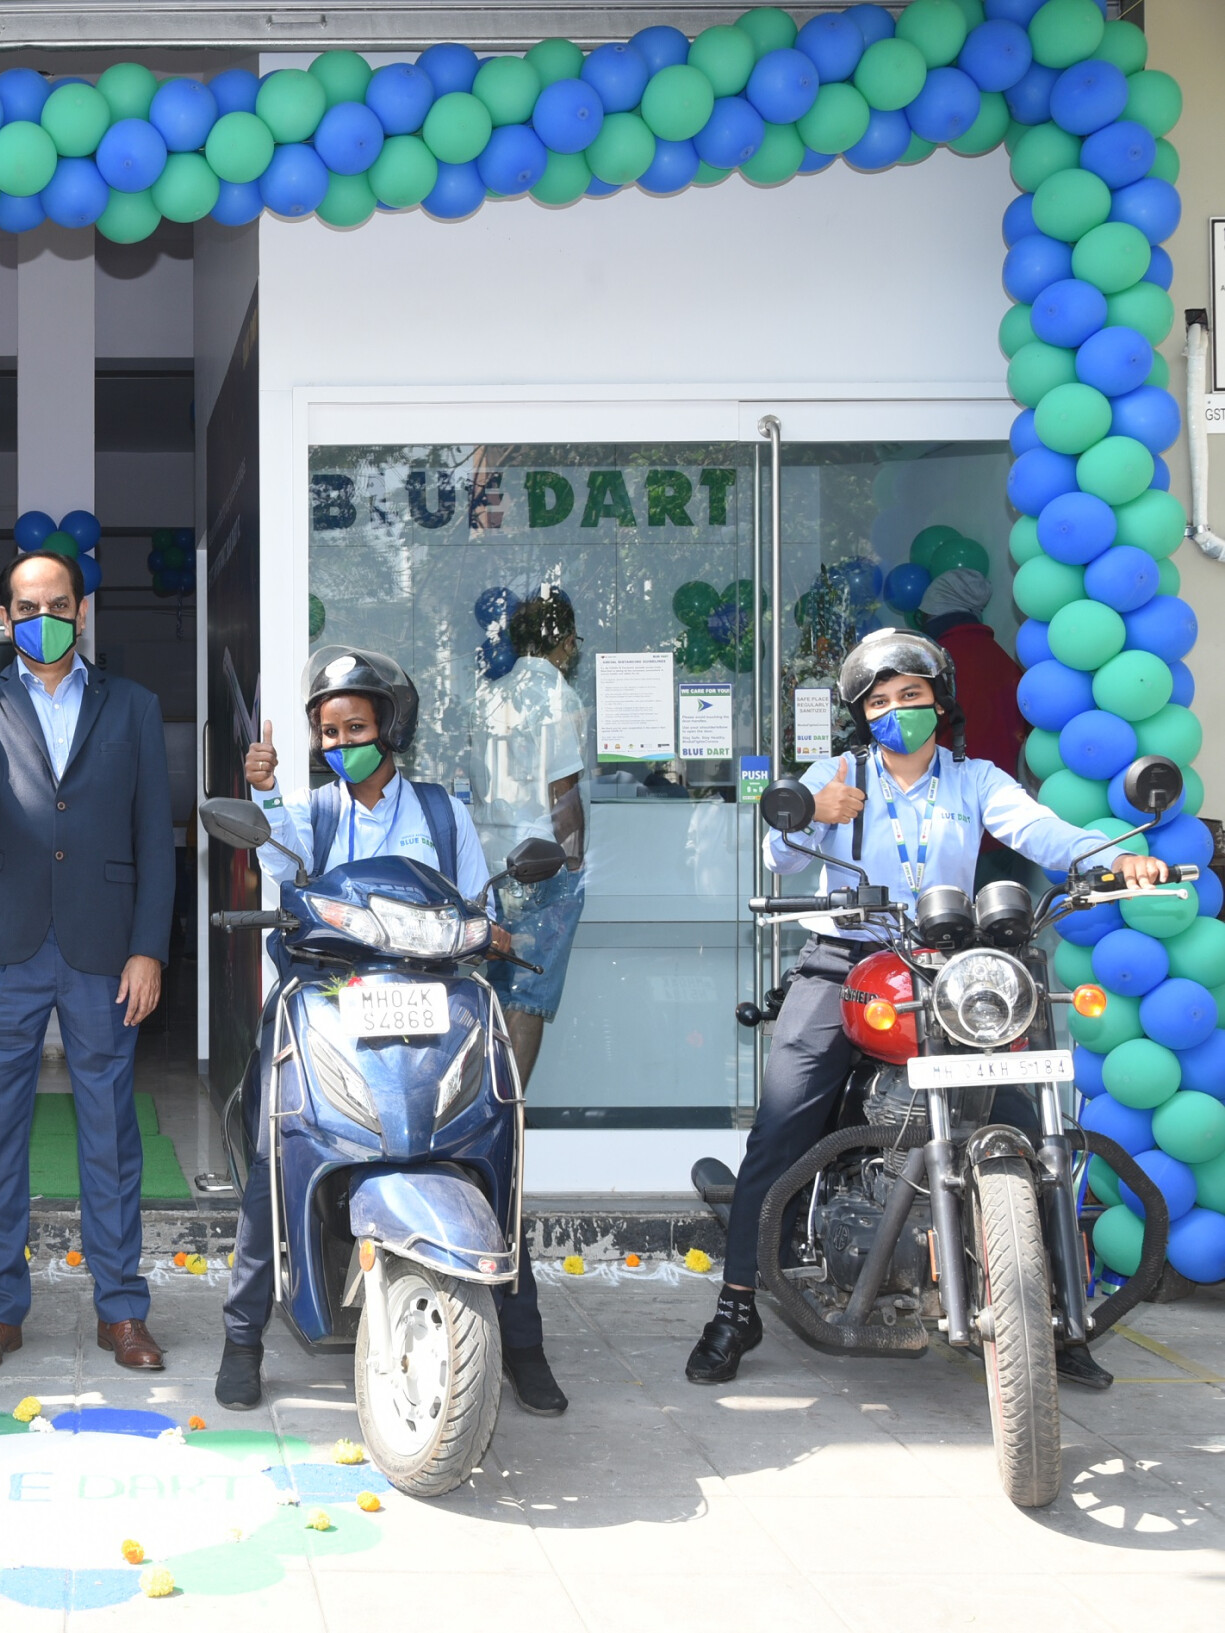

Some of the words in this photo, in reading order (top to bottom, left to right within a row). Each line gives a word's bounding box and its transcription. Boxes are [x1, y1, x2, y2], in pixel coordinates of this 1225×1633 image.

[524, 468, 737, 528] DART
[682, 748, 704, 756] BLUE
[706, 748, 730, 756] DART
[741, 771, 768, 780] PUSH
[400, 838, 420, 847] BLUE
[362, 988, 434, 1009] MH04K
[78, 1472, 255, 1501] DART
